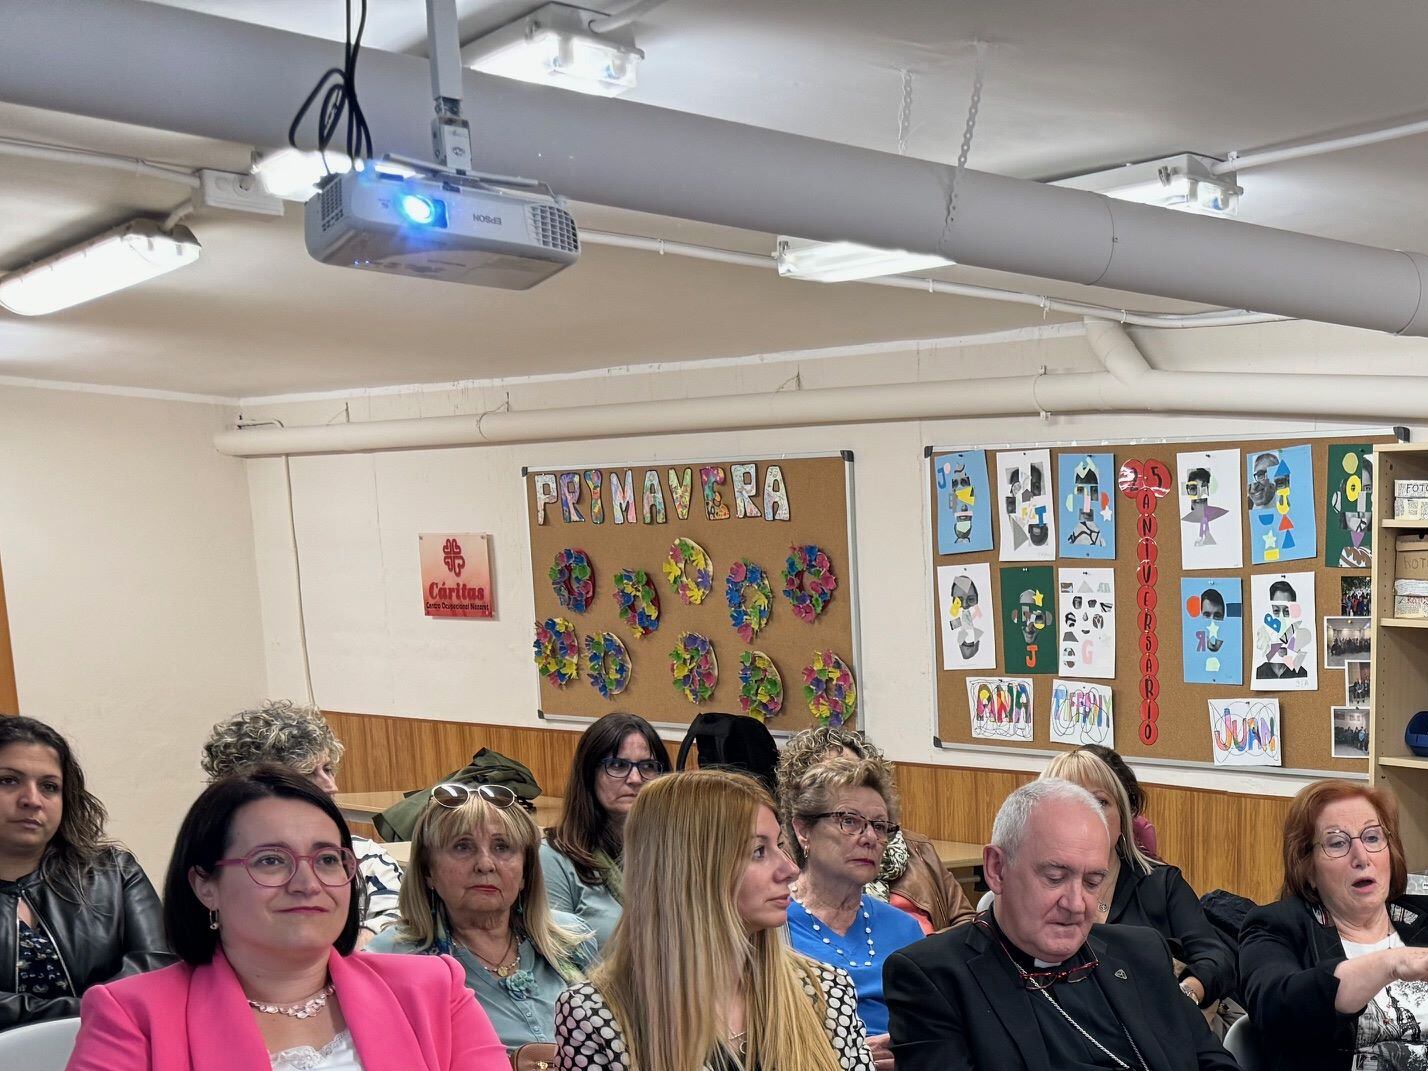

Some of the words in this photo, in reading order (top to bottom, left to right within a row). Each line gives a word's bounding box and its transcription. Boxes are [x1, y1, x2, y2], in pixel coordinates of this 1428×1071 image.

[473, 214, 502, 225] EPSON
[534, 463, 791, 526] PRIMAVERA
[429, 582, 485, 600] Cáritas
[1214, 708, 1276, 752] JUAN
